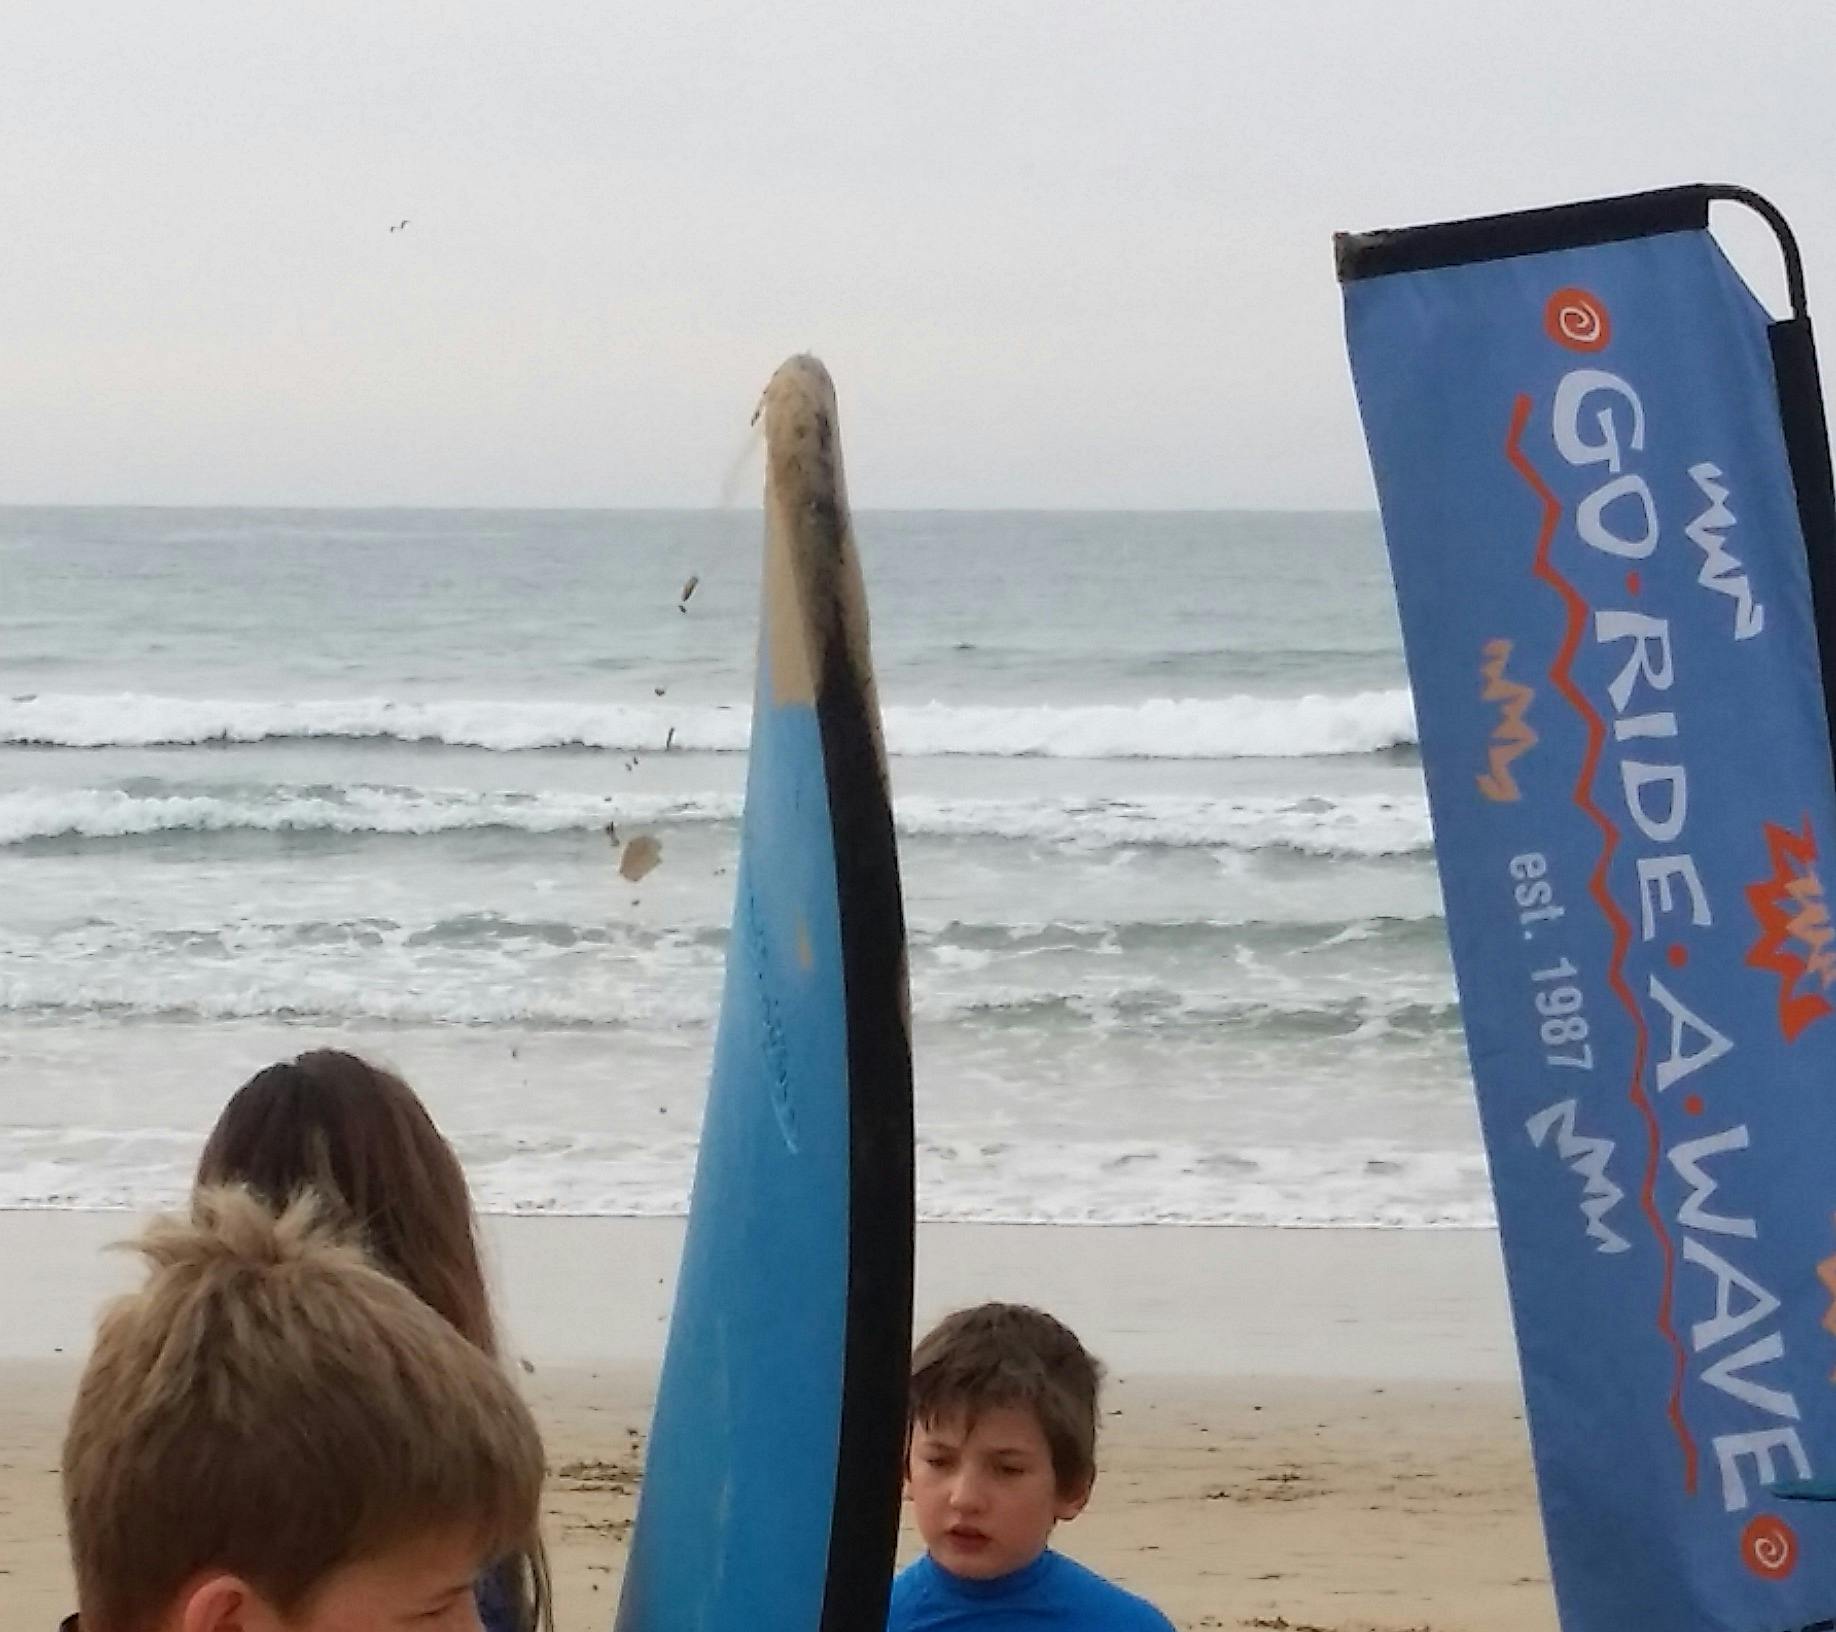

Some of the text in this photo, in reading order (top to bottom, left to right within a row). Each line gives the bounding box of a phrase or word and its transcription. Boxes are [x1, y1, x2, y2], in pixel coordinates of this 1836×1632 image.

[1509, 852, 1594, 1071] est. 1987
[1552, 369, 1813, 1513] GO RIDE A WAVE
